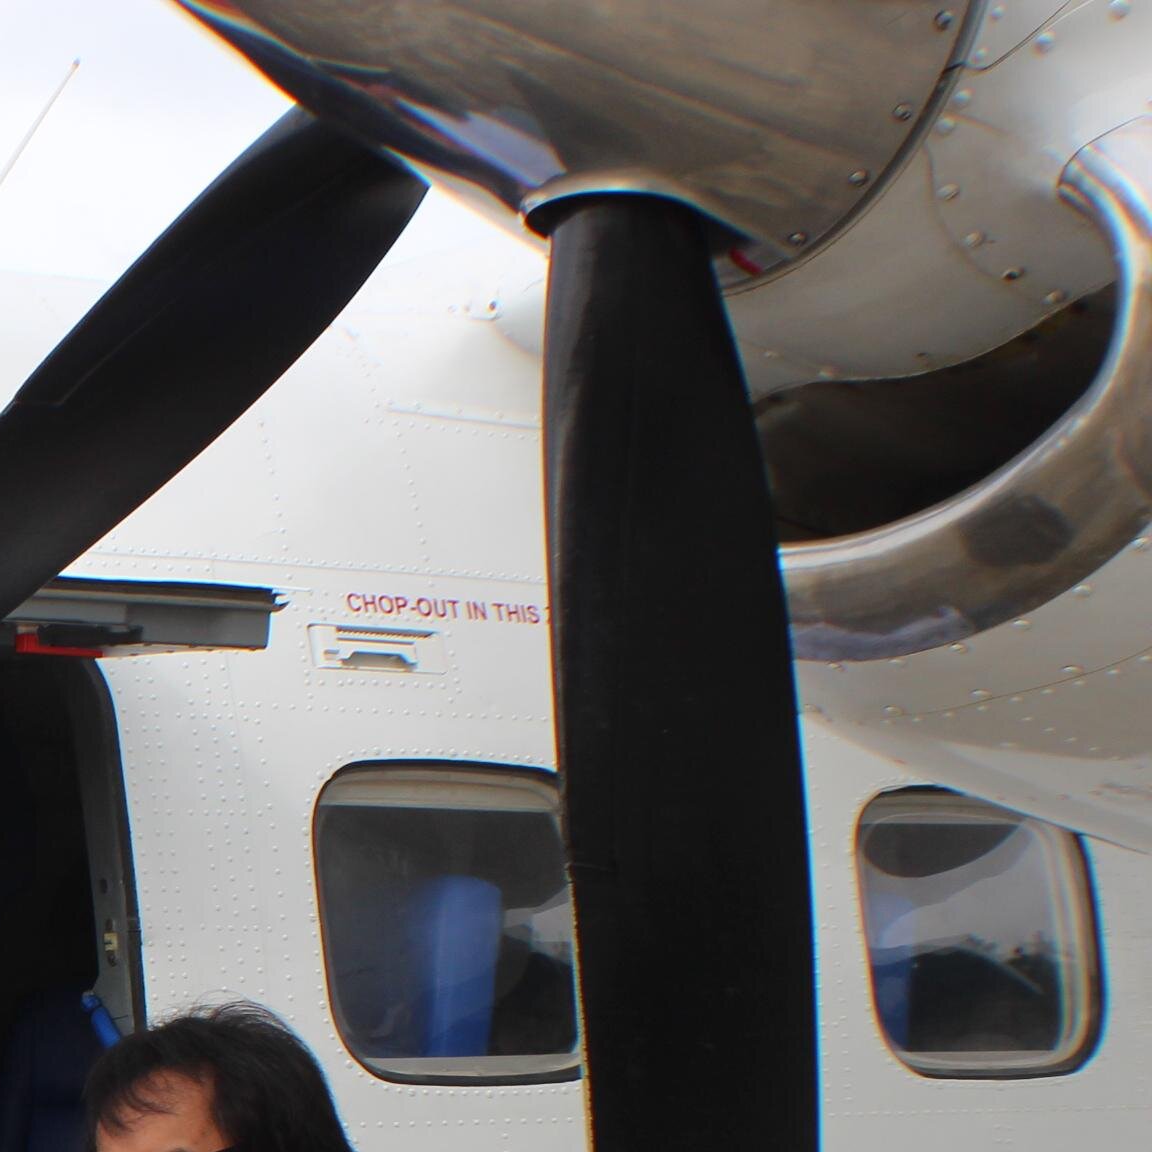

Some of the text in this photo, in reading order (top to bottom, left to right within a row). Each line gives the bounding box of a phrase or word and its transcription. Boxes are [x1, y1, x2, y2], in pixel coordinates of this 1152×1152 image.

[346, 592, 459, 619] CHOP-OUT
[466, 600, 488, 621] IN
[492, 602, 540, 624] THIS
